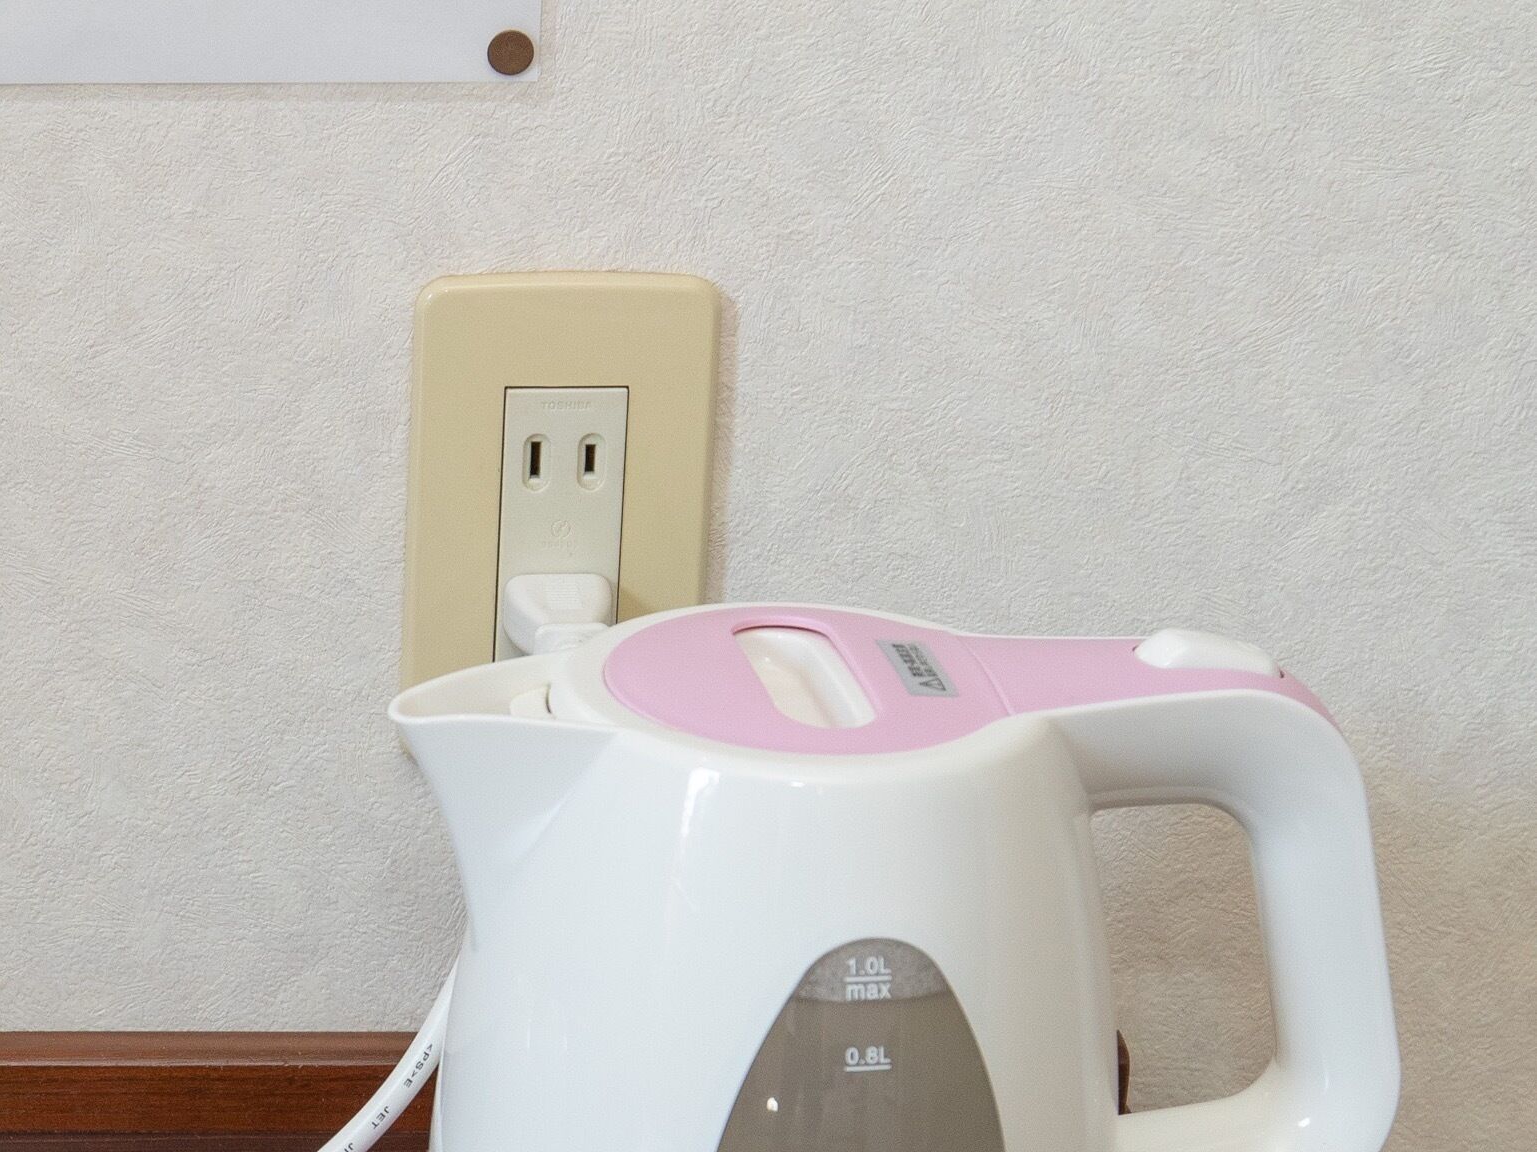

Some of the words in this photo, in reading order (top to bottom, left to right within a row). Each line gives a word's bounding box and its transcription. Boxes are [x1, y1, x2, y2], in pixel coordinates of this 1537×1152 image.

[847, 956, 892, 975] 1.0L
[846, 982, 892, 1001] max
[845, 1046, 892, 1066] 0.8L
[371, 1105, 390, 1130] JET
